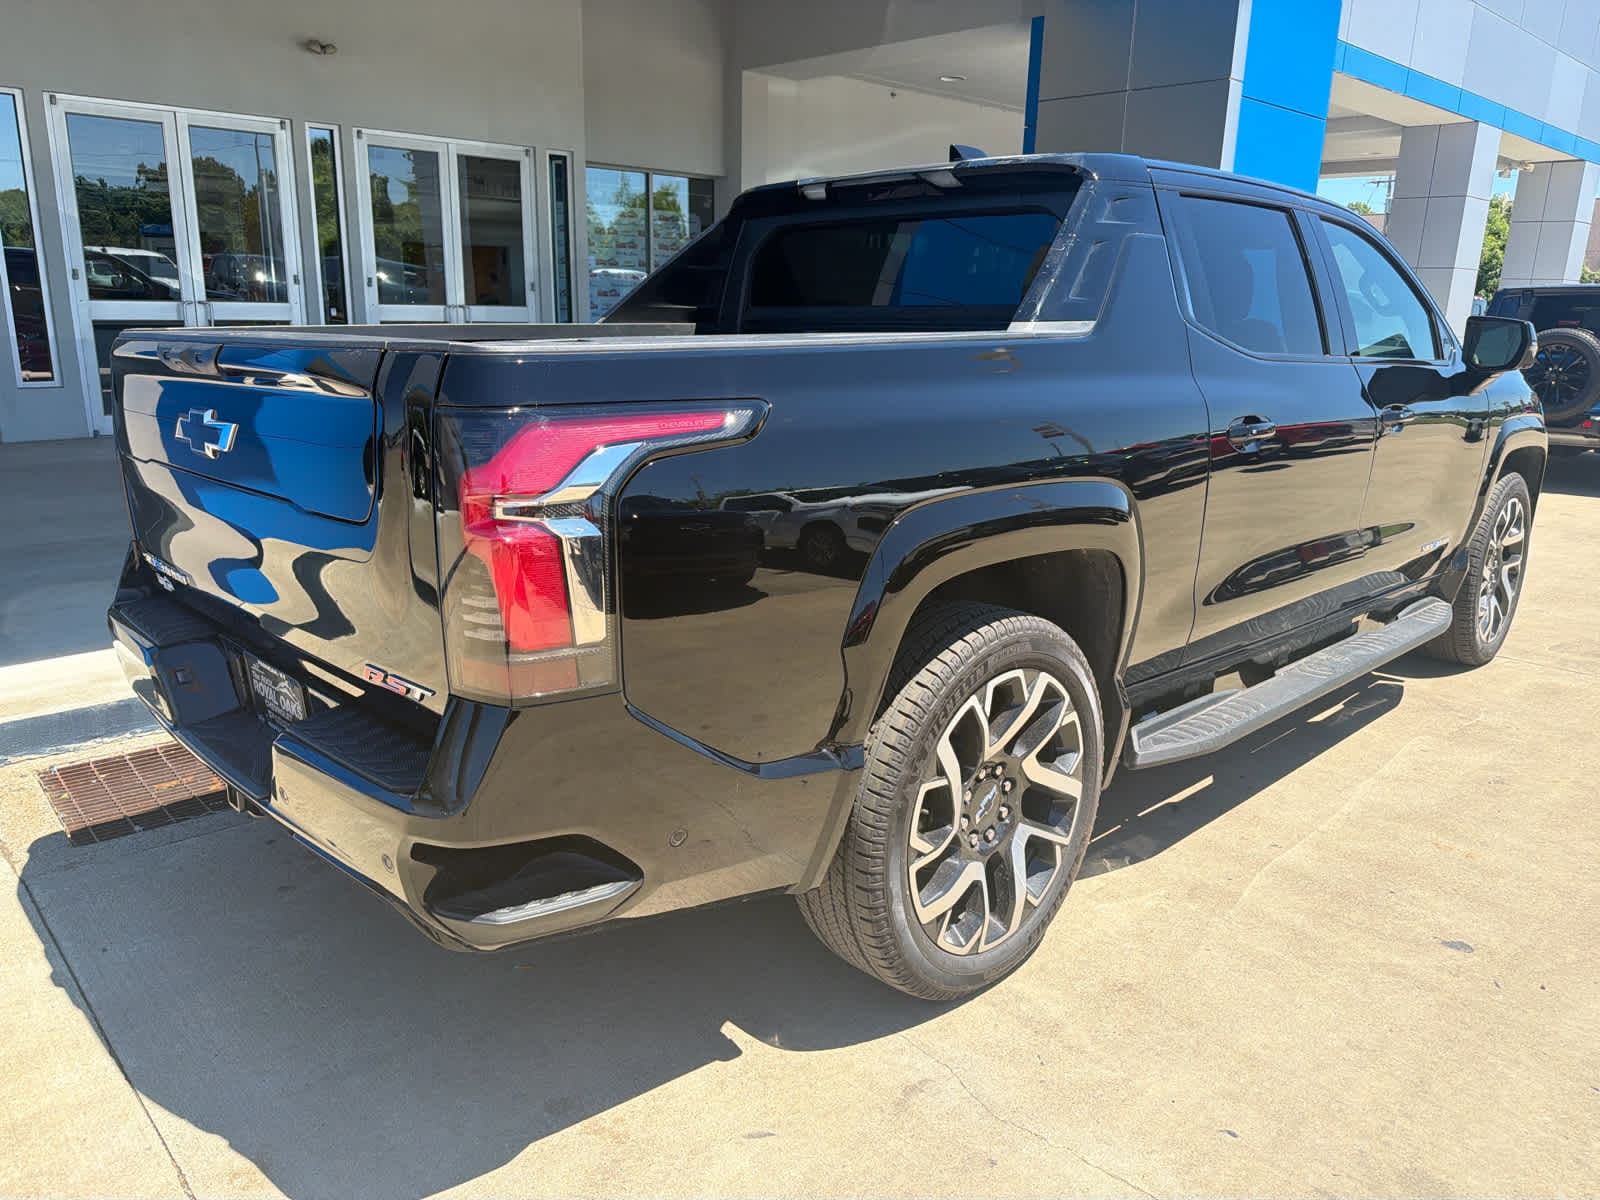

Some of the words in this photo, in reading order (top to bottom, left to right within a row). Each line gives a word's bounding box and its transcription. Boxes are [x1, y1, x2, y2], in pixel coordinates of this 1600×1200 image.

[252, 679, 279, 705] ROYAL
[279, 696, 304, 721] OAKS
[363, 663, 437, 701] RST
